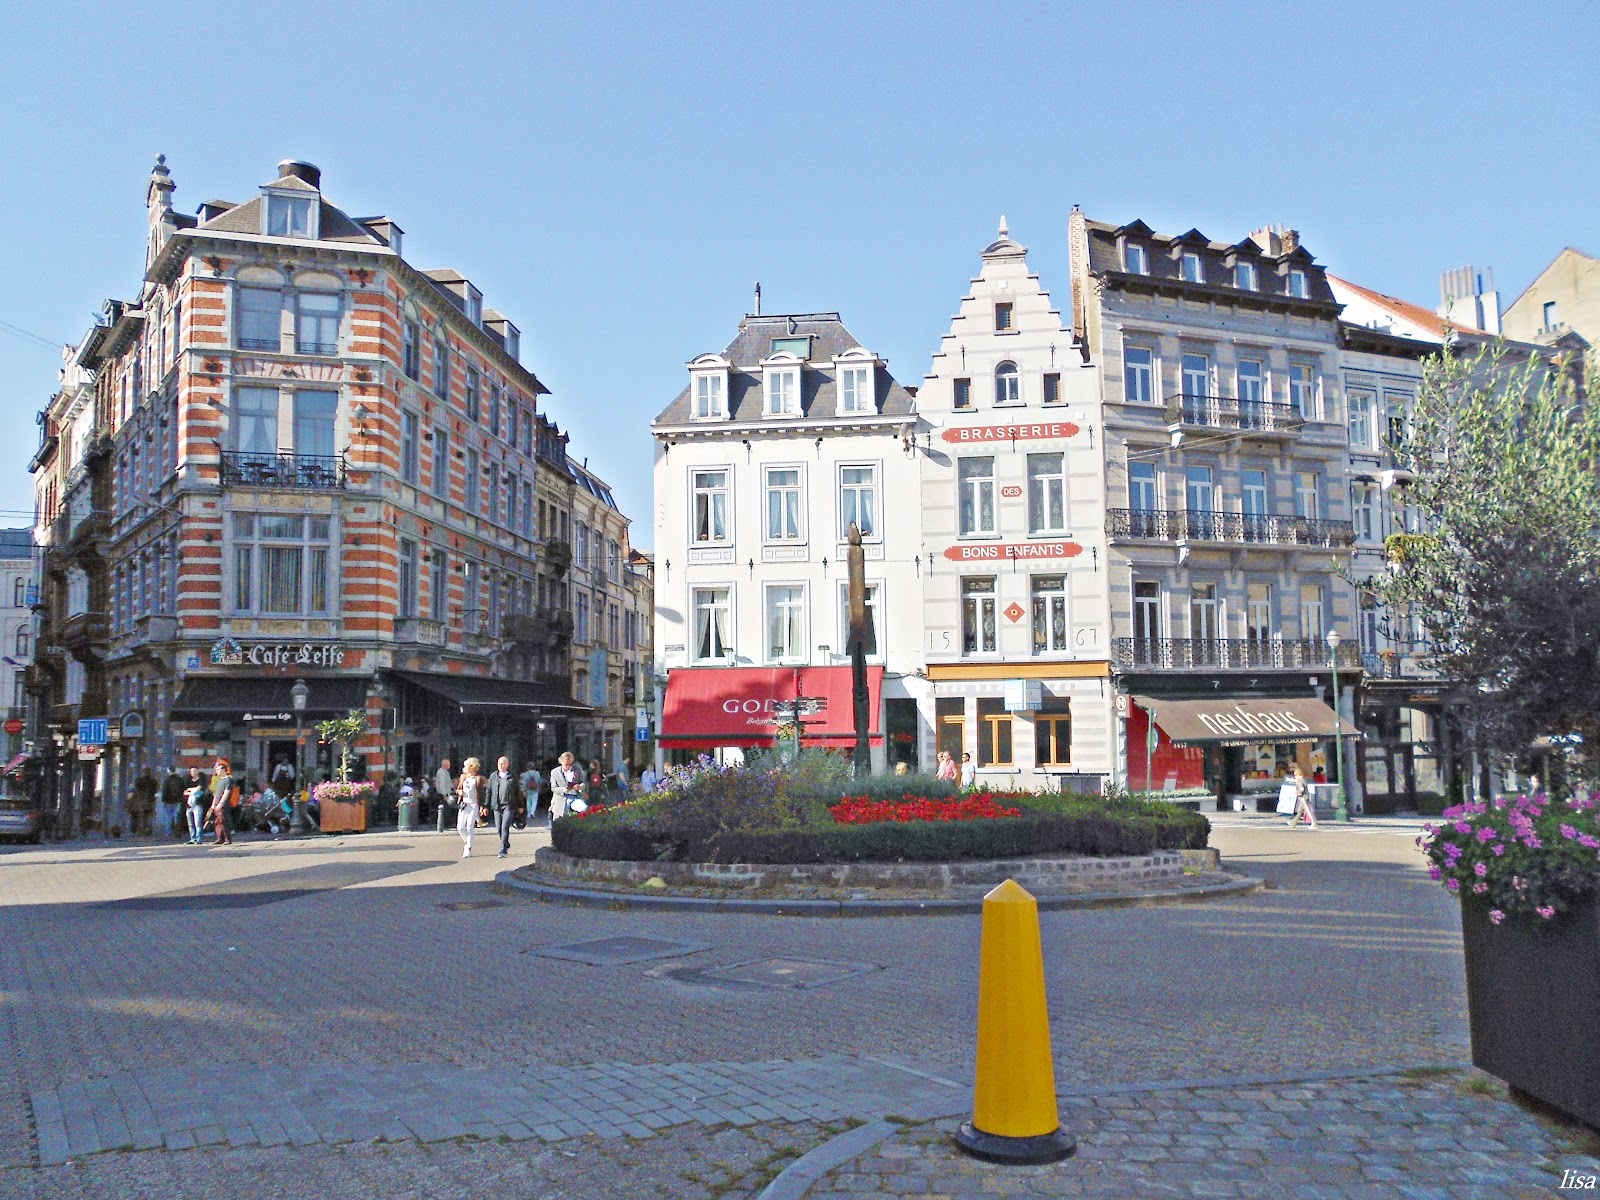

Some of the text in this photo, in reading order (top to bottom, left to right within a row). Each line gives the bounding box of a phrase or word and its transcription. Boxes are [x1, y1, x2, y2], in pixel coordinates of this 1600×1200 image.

[960, 424, 1061, 440] BRASSERIE
[1003, 487, 1020, 496] DES
[962, 544, 1064, 558] BONS ENFANTS
[250, 643, 344, 667] Café Leffe
[1197, 706, 1310, 735] neuhaus
